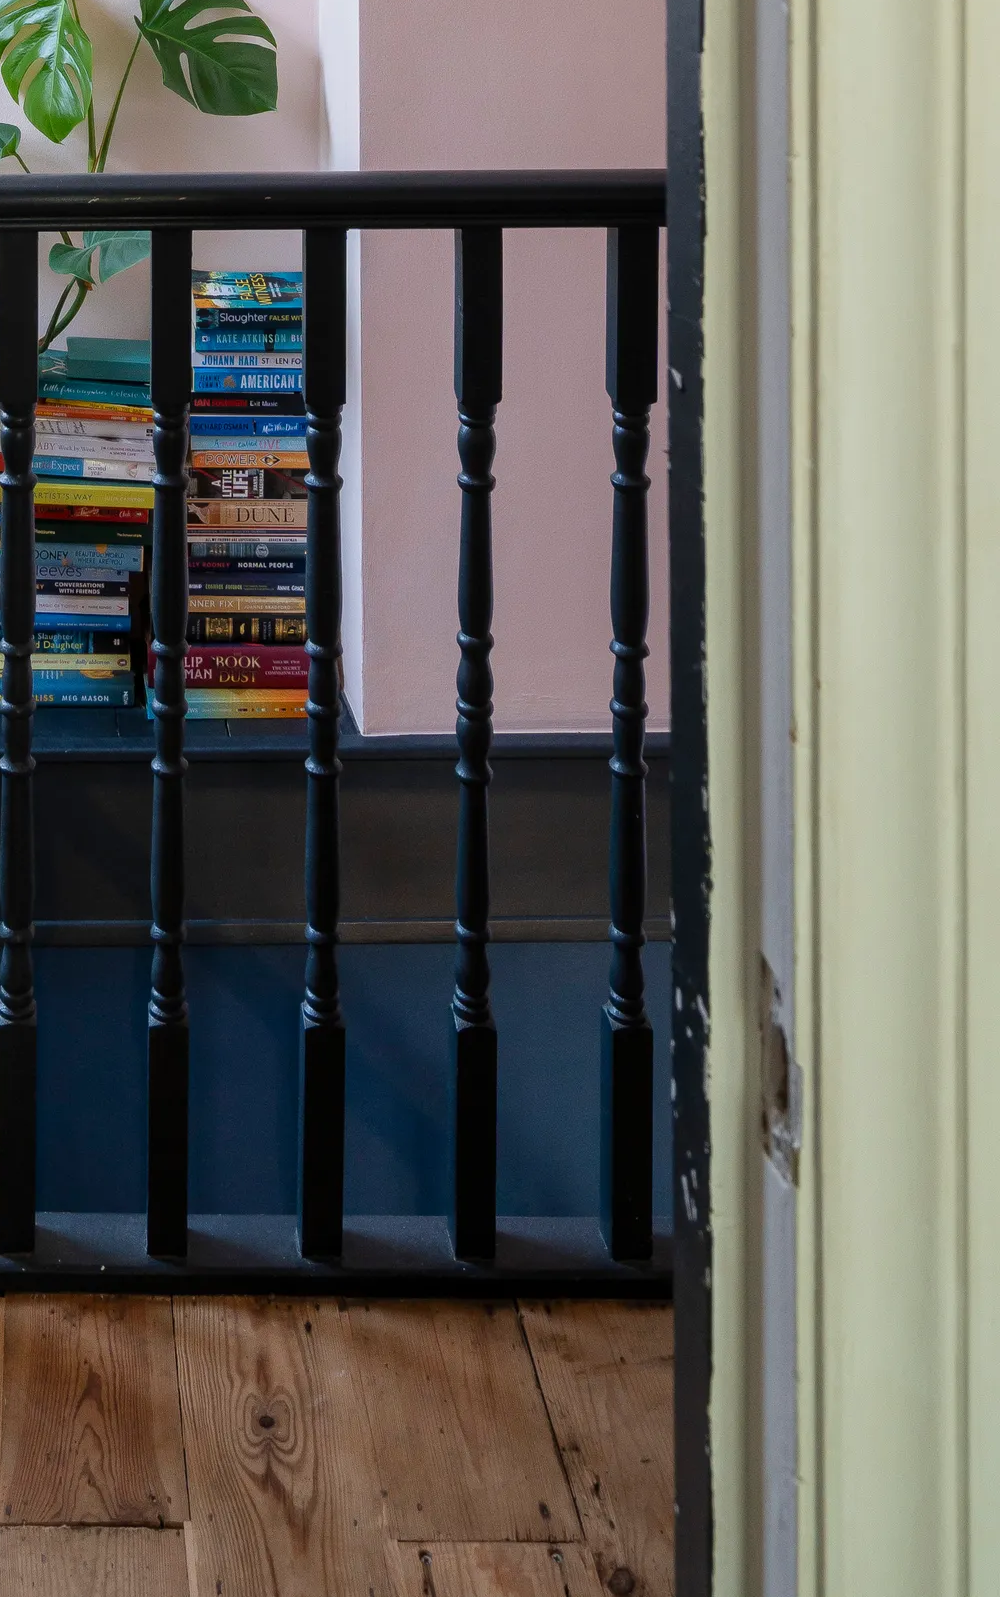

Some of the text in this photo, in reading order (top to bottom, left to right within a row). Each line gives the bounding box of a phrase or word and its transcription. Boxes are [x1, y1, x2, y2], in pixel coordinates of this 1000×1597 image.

[235, 278, 254, 301] FALSE
[249, 273, 273, 306] WITNESS
[219, 313, 268, 324] Slaughter
[216, 334, 237, 343] KATE
[242, 334, 287, 343] ATKINSON
[202, 355, 235, 366] JOHANN
[238, 355, 257, 366] HARI
[240, 374, 295, 389] AMERICAN
[110, 390, 139, 399] Celeste
[36, 442, 55, 451] ABY
[80, 445, 96, 453] Week
[204, 453, 258, 466] POWER
[51, 460, 80, 472] Expect
[222, 469, 232, 498] LITTLE
[233, 469, 249, 498] LIFE
[73, 493, 93, 501] WAY
[235, 506, 295, 523] DUNE
[34, 550, 69, 561] OONEY
[36, 565, 82, 577] leeves
[189, 600, 216, 608] NNER
[219, 600, 234, 608] FIX
[37, 633, 74, 642] Slaughter
[43, 640, 83, 651] Daughter
[212, 655, 261, 669] BOOK
[218, 671, 257, 683] DUST
[32, 693, 54, 702] LISS
